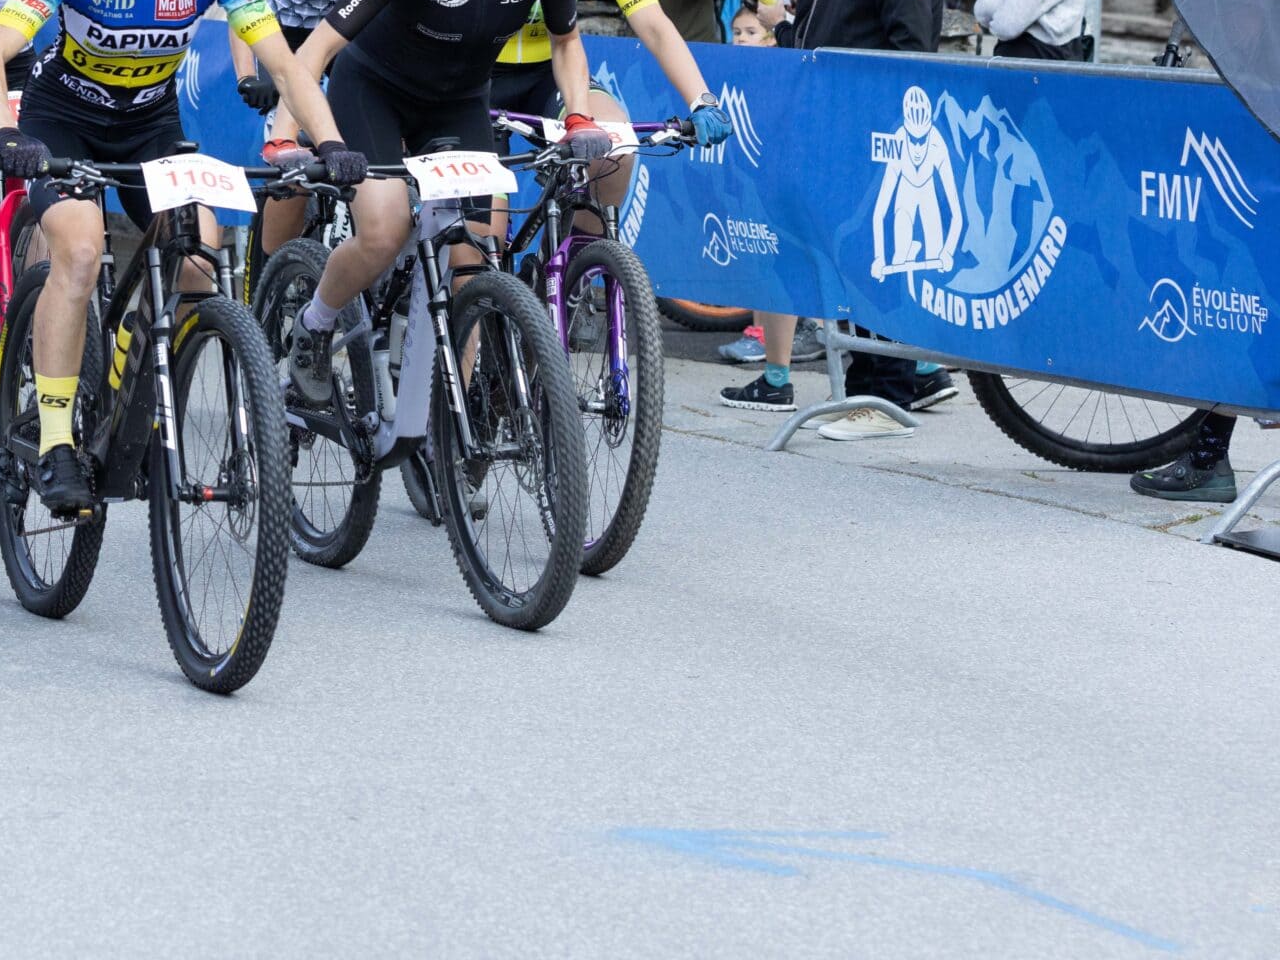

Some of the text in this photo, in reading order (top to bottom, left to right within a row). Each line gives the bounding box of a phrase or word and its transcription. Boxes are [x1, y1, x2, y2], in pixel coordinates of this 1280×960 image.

[86, 25, 191, 50] PAPIVAL
[59, 73, 117, 109] NENDAZ
[874, 137, 903, 161] FMV
[166, 169, 234, 192] 1105
[430, 161, 492, 178] 1101
[1140, 171, 1202, 223] FMV
[727, 215, 772, 240] ÉVOLÈNE
[921, 215, 1068, 330] RAID EVOLENARD
[1192, 282, 1261, 316] ÉVOLÈNE
[39, 393, 71, 409] GS
